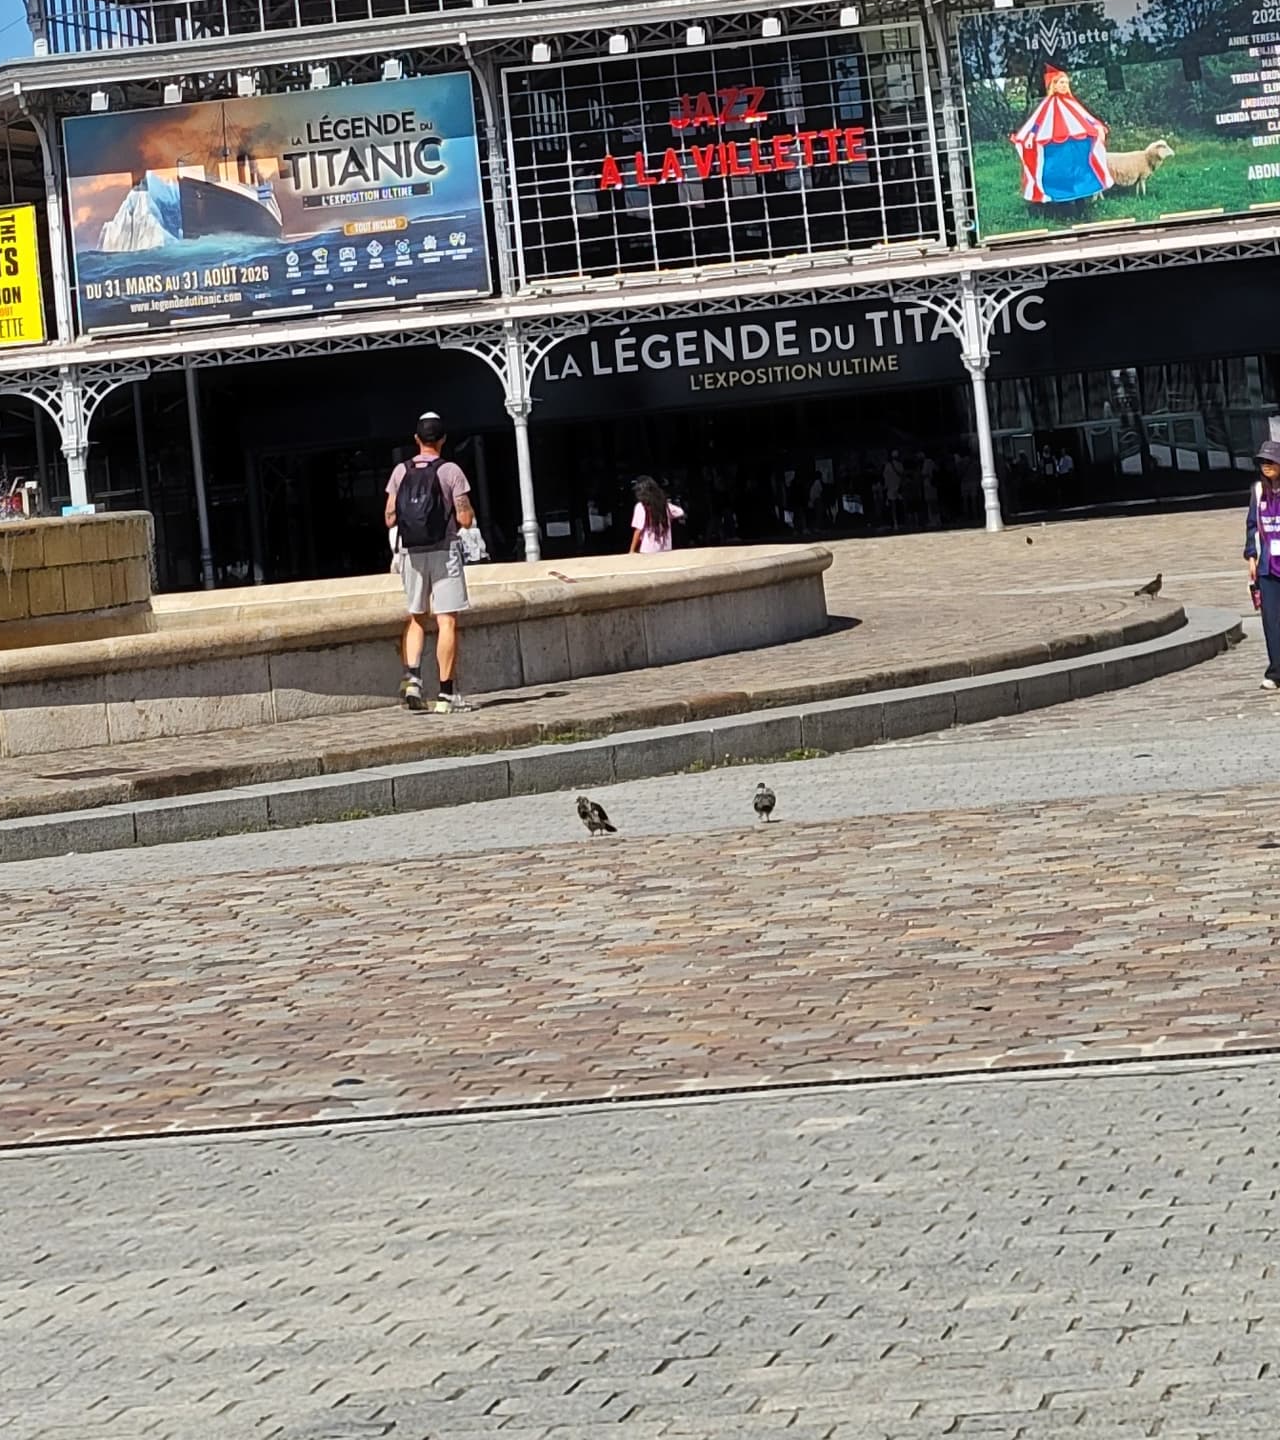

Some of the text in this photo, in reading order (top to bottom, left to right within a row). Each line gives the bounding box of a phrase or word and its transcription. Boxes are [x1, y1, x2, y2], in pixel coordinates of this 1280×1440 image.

[1228, 35, 1250, 47] ANNE
[1251, 32, 1280, 44] TERESA
[670, 86, 768, 129] JAZZ
[1216, 111, 1250, 125] LUCINDA
[291, 111, 433, 146] LA LÉGENDE DU
[284, 137, 445, 190] TITANIC
[635, 148, 684, 186] LA
[691, 127, 868, 180] VILLETTE
[321, 186, 413, 206] L'EXPOSITION ULTIME
[0, 214, 17, 244] THE
[86, 283, 102, 300] DU
[105, 279, 121, 298] 31
[125, 274, 163, 296] MARS
[166, 276, 180, 291] AU
[183, 271, 198, 289] 31
[204, 263, 238, 287] AOÛT
[240, 266, 269, 284] 2026
[130, 292, 242, 313] www.legendedutitanic.com
[543, 354, 583, 381] LA
[590, 320, 800, 377] LÉGENDE
[810, 324, 855, 353] DU
[690, 355, 900, 391] L'EXPOSITION ULTIME
